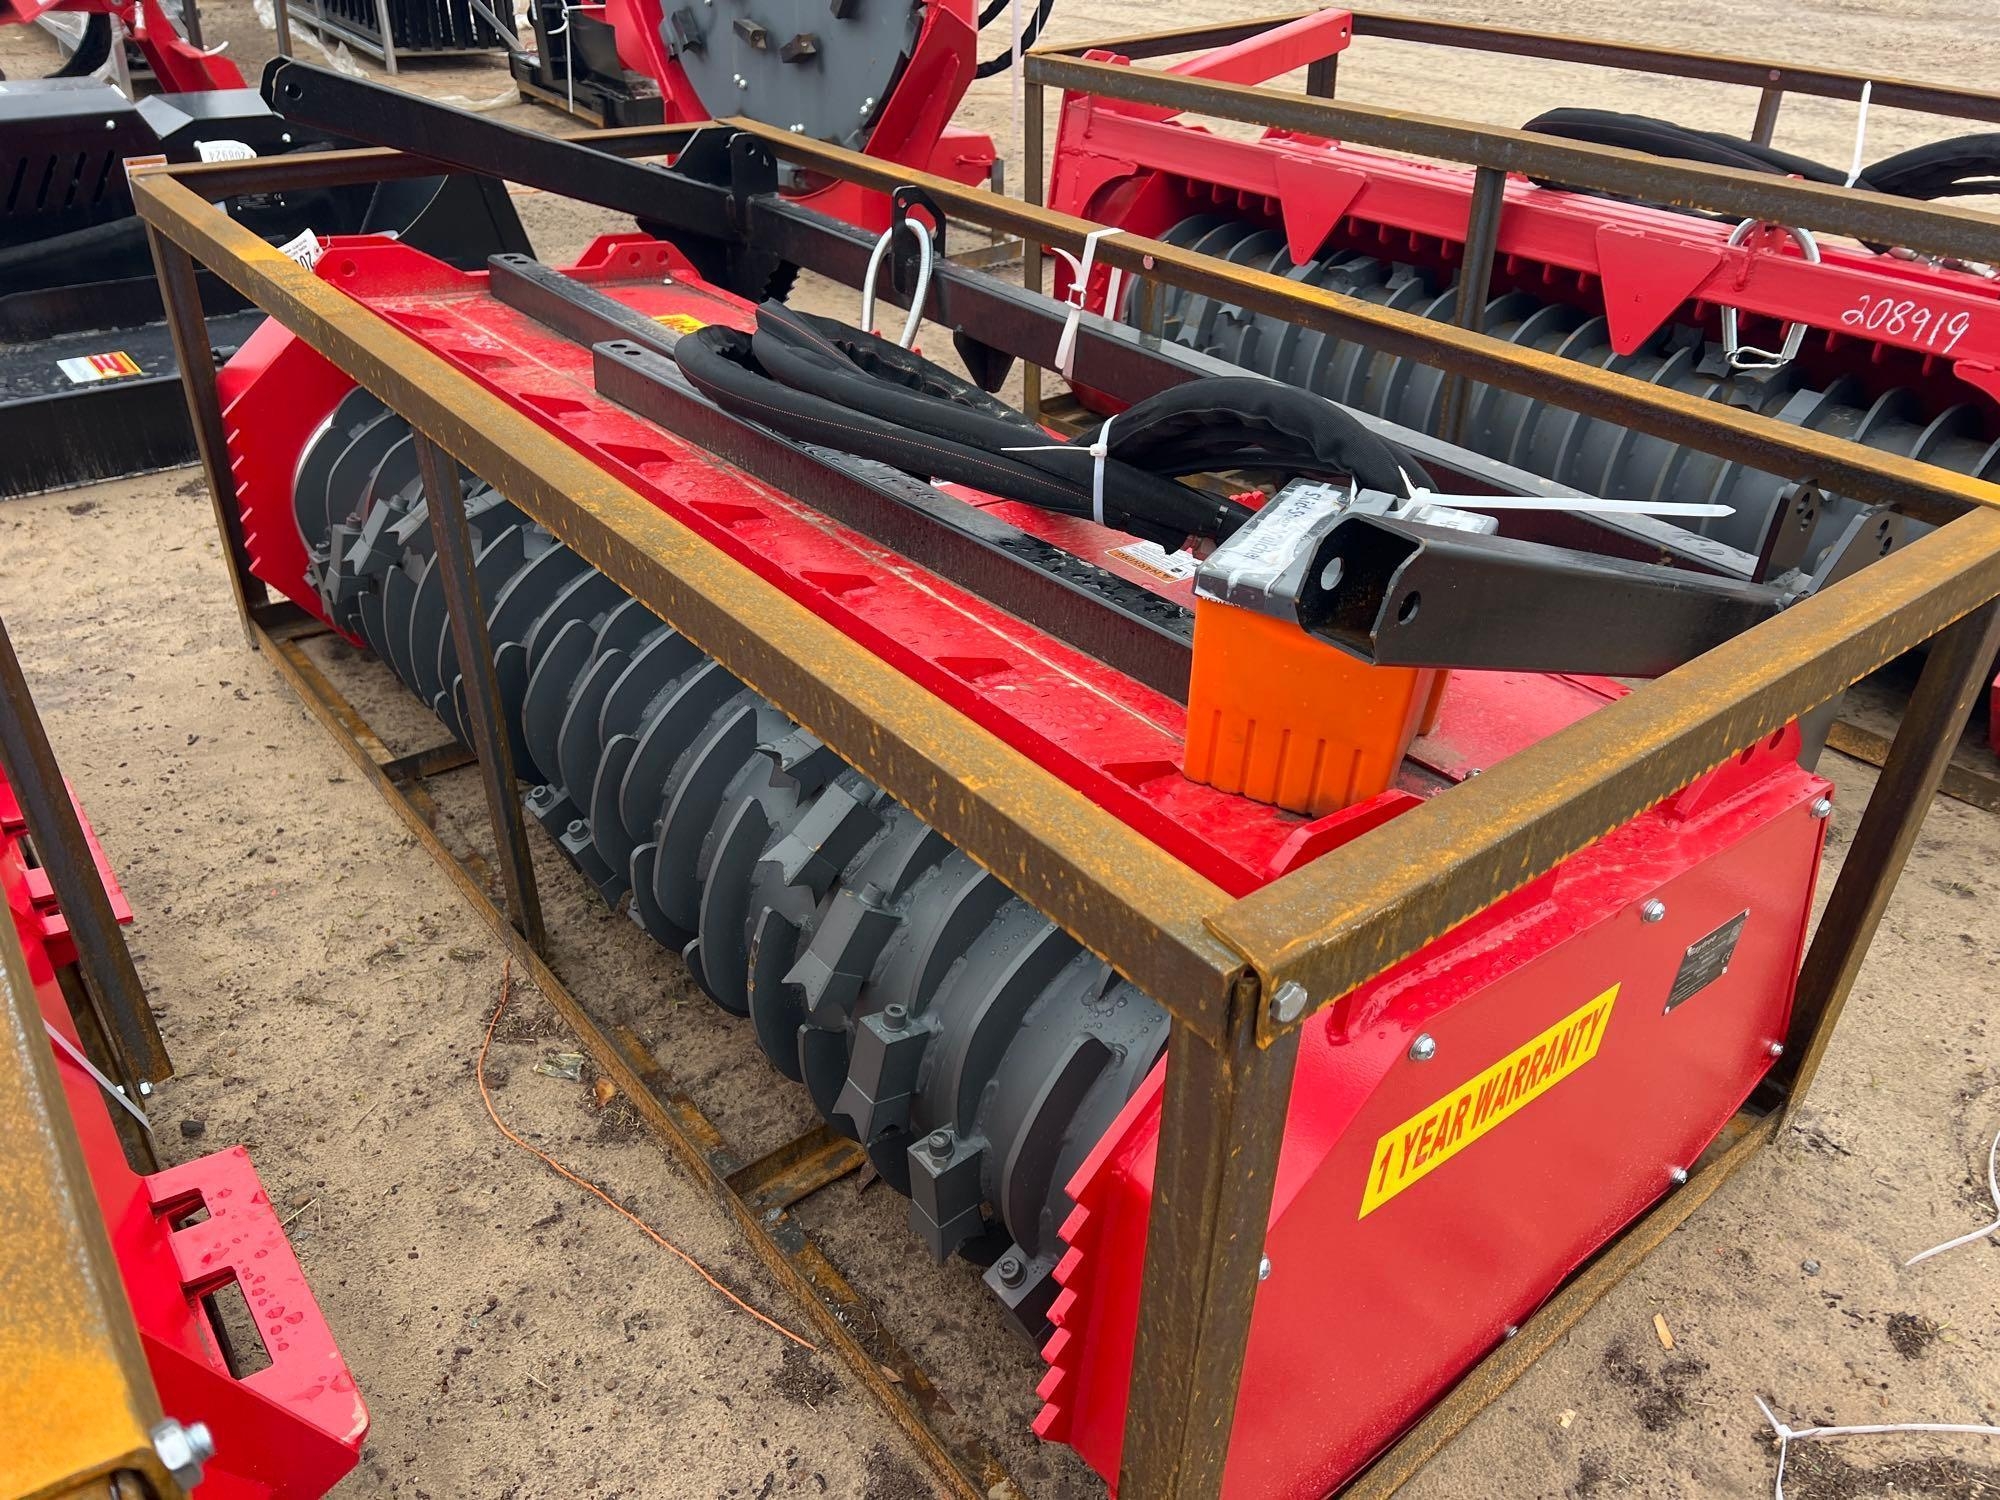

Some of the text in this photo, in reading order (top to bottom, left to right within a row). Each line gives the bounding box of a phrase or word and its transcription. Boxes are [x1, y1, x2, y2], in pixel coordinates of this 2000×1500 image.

[1840, 294, 1971, 355] 208919
[1377, 1001, 1609, 1195] 1 YEAR WARRANTY
